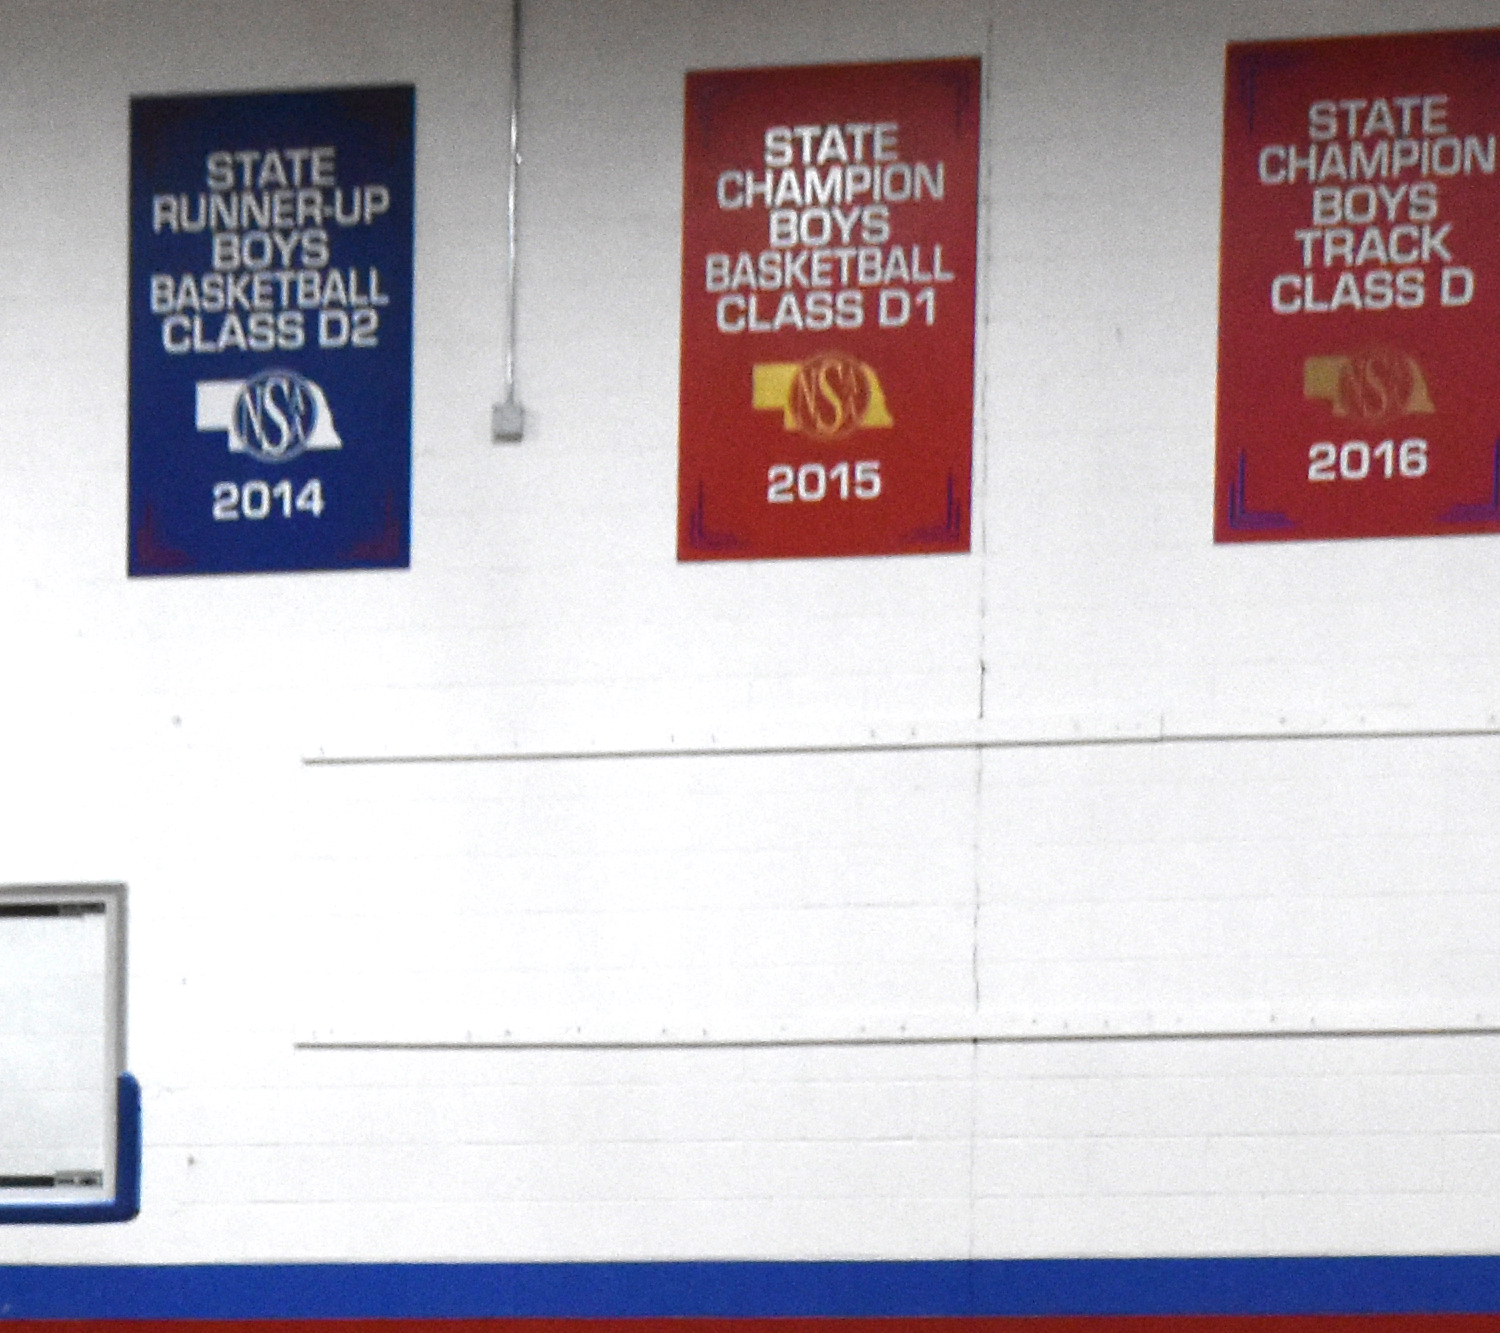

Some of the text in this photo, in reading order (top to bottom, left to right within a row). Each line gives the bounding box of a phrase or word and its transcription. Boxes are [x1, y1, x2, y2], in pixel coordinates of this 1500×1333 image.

[1308, 94, 1448, 140] STATE
[765, 121, 899, 167] STATE
[1258, 134, 1496, 185] CHAMPION
[207, 146, 335, 190] STATE
[717, 161, 944, 209] CHAMPION
[153, 185, 390, 233] RUNNER-UP
[769, 204, 890, 247] BOYS
[1313, 181, 1438, 225] BOYS
[212, 228, 329, 271] BOYS
[705, 244, 954, 292] BASKETBALL
[1295, 223, 1452, 269] TRACK
[151, 267, 389, 314] BASKETBALL
[716, 287, 936, 333] CLASS D1
[1271, 266, 1475, 314] CLASS D
[162, 308, 379, 354] CLASS D2
[767, 461, 881, 503] 2015
[1308, 439, 1430, 482] 2016
[212, 482, 324, 519] 2014
